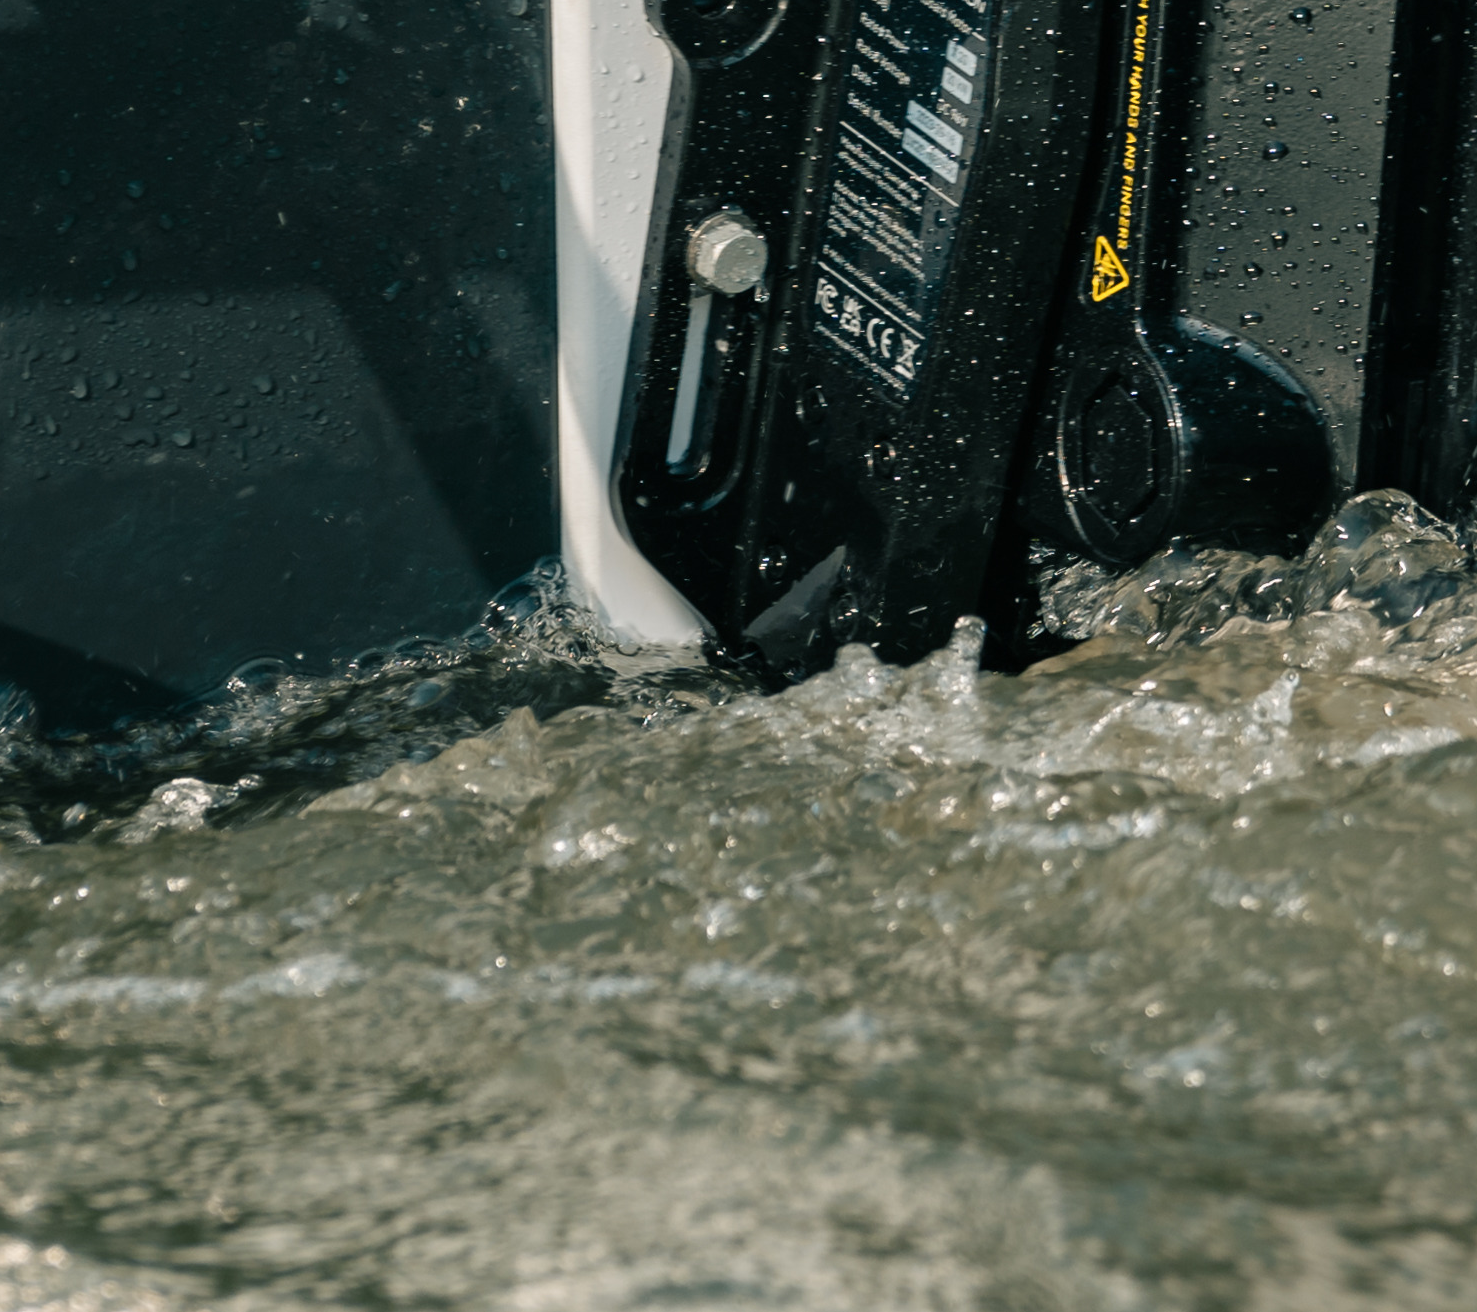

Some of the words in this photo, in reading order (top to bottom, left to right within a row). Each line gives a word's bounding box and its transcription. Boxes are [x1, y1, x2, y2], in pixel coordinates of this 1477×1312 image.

[1133, 15, 1149, 62] YOUR
[1128, 66, 1144, 128] HANDS
[1123, 132, 1138, 170] AND
[1116, 175, 1134, 250] FINGERS
